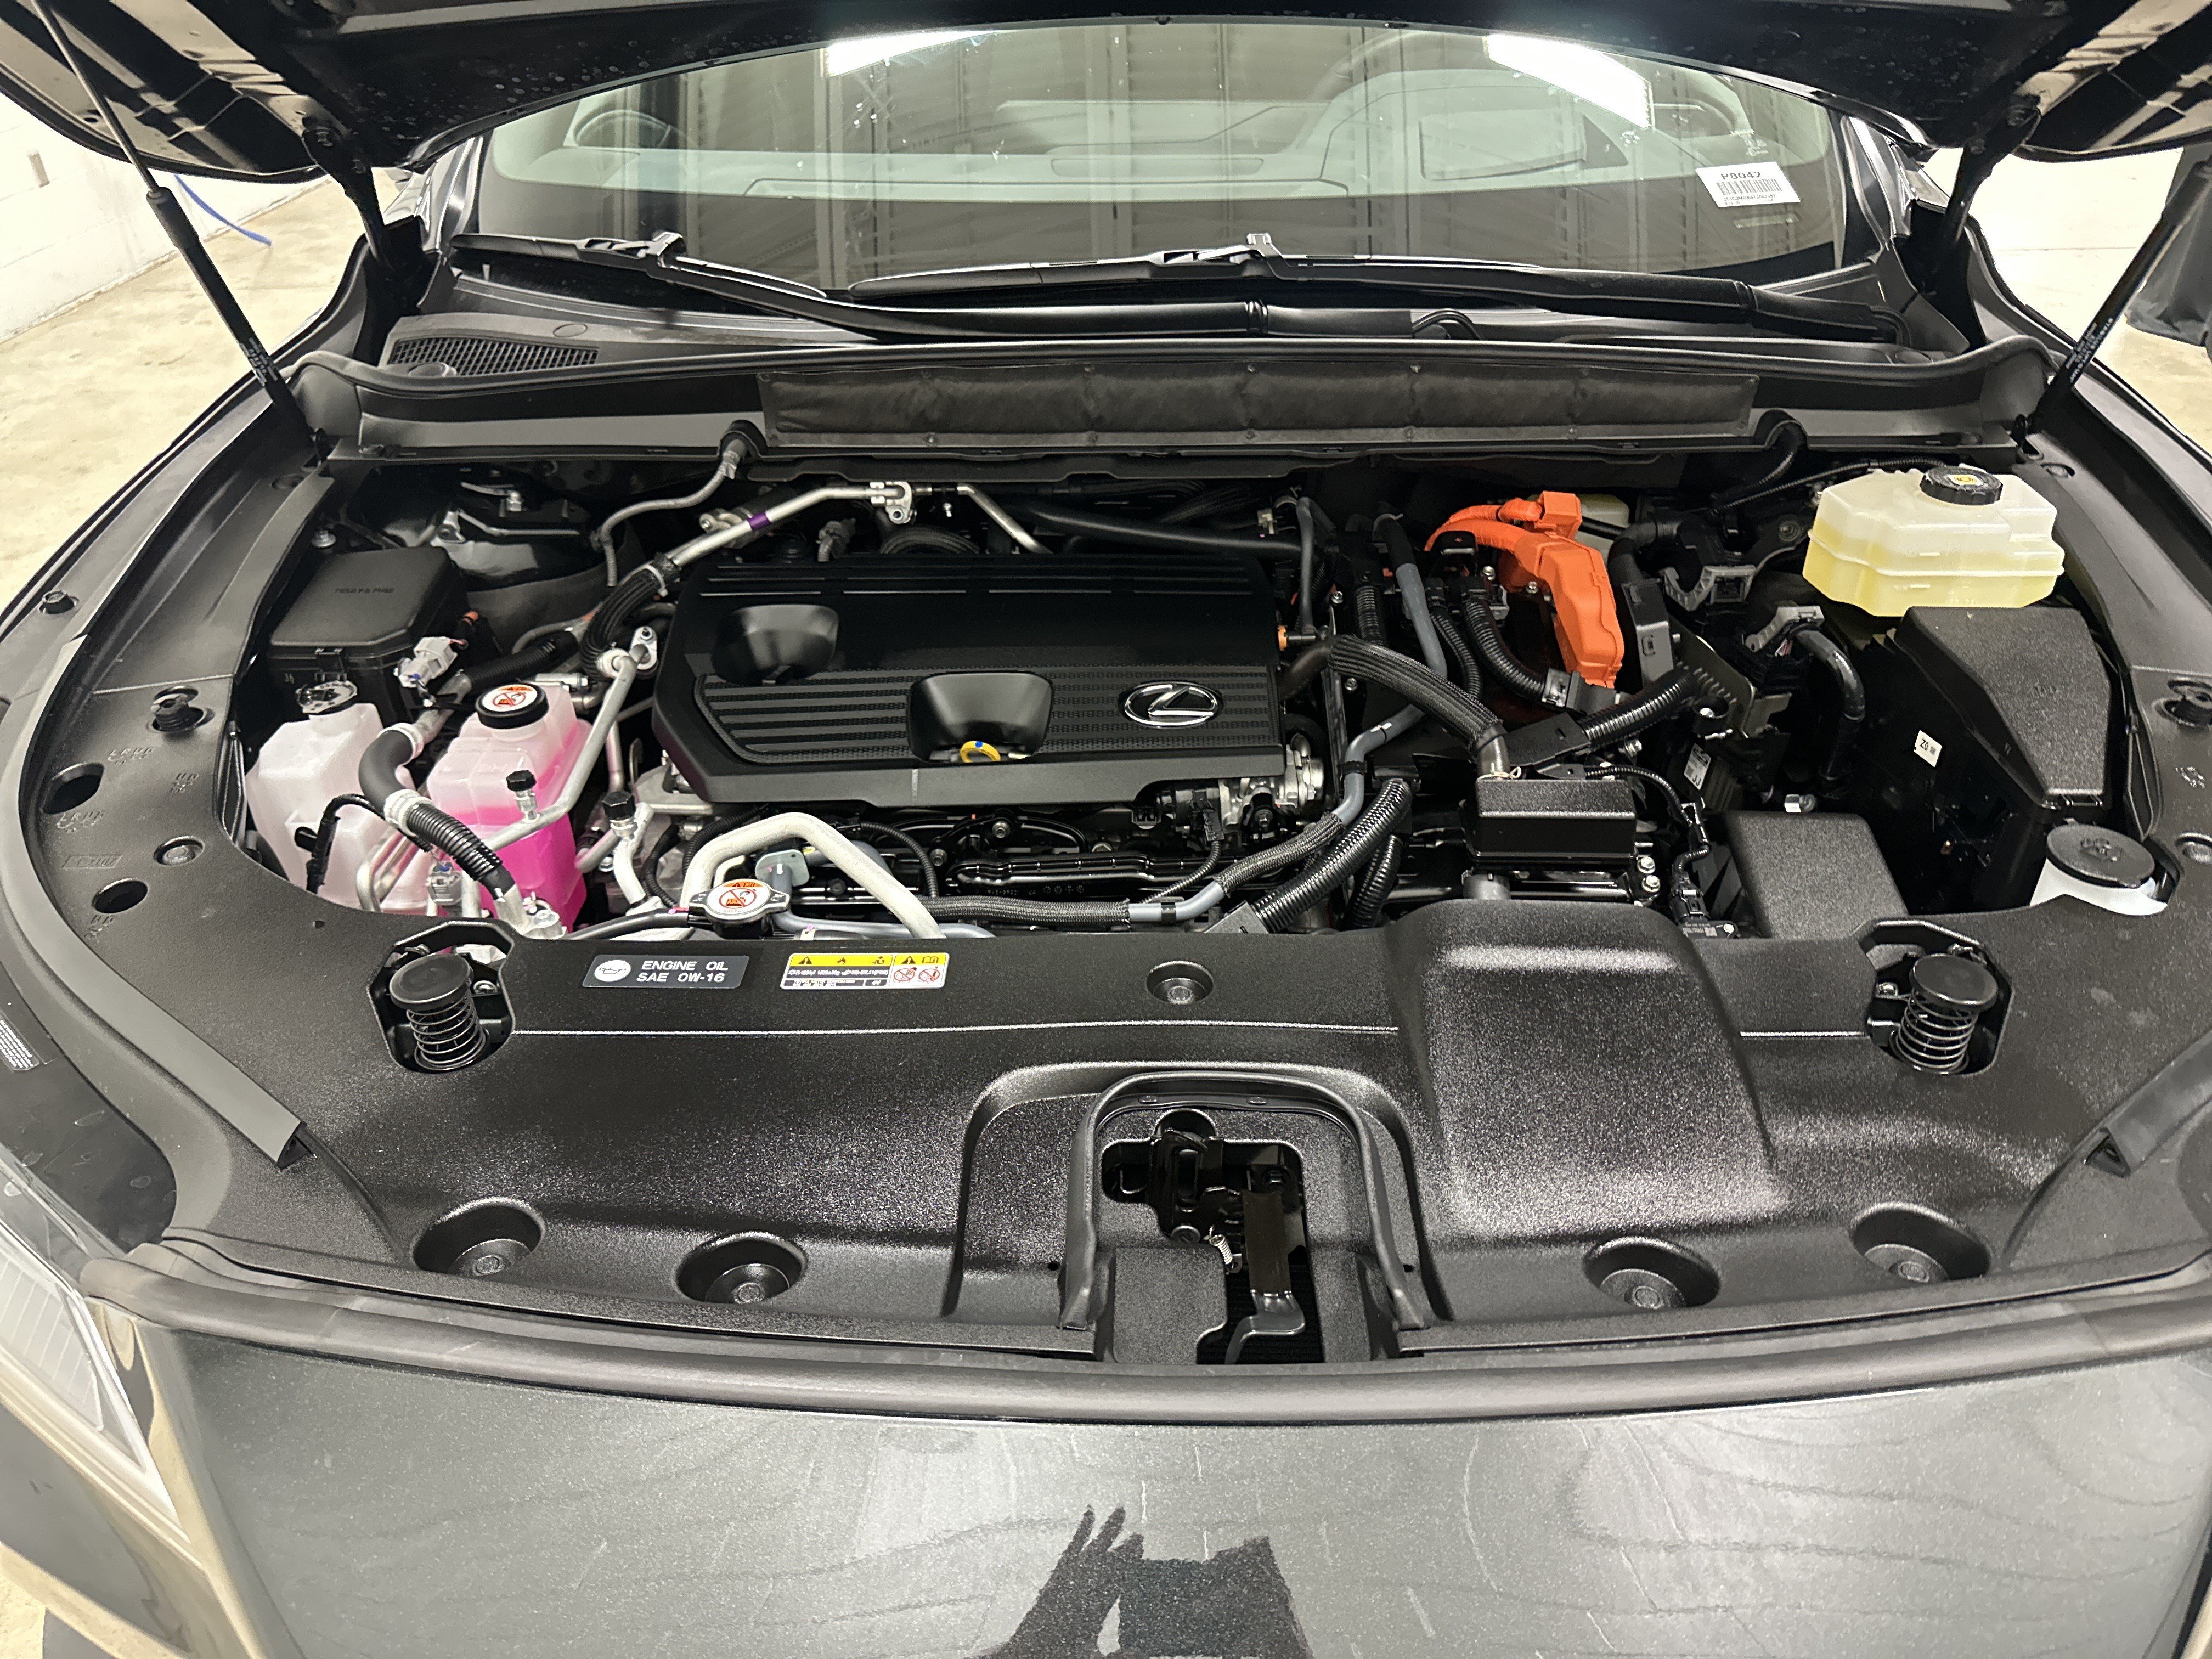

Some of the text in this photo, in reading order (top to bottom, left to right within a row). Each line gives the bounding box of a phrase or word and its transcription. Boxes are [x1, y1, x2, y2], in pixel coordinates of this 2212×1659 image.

[1720, 171, 1763, 180] P8042
[641, 961, 729, 970] ENGINE OIL
[636, 972, 725, 982] SAE 0W-16
